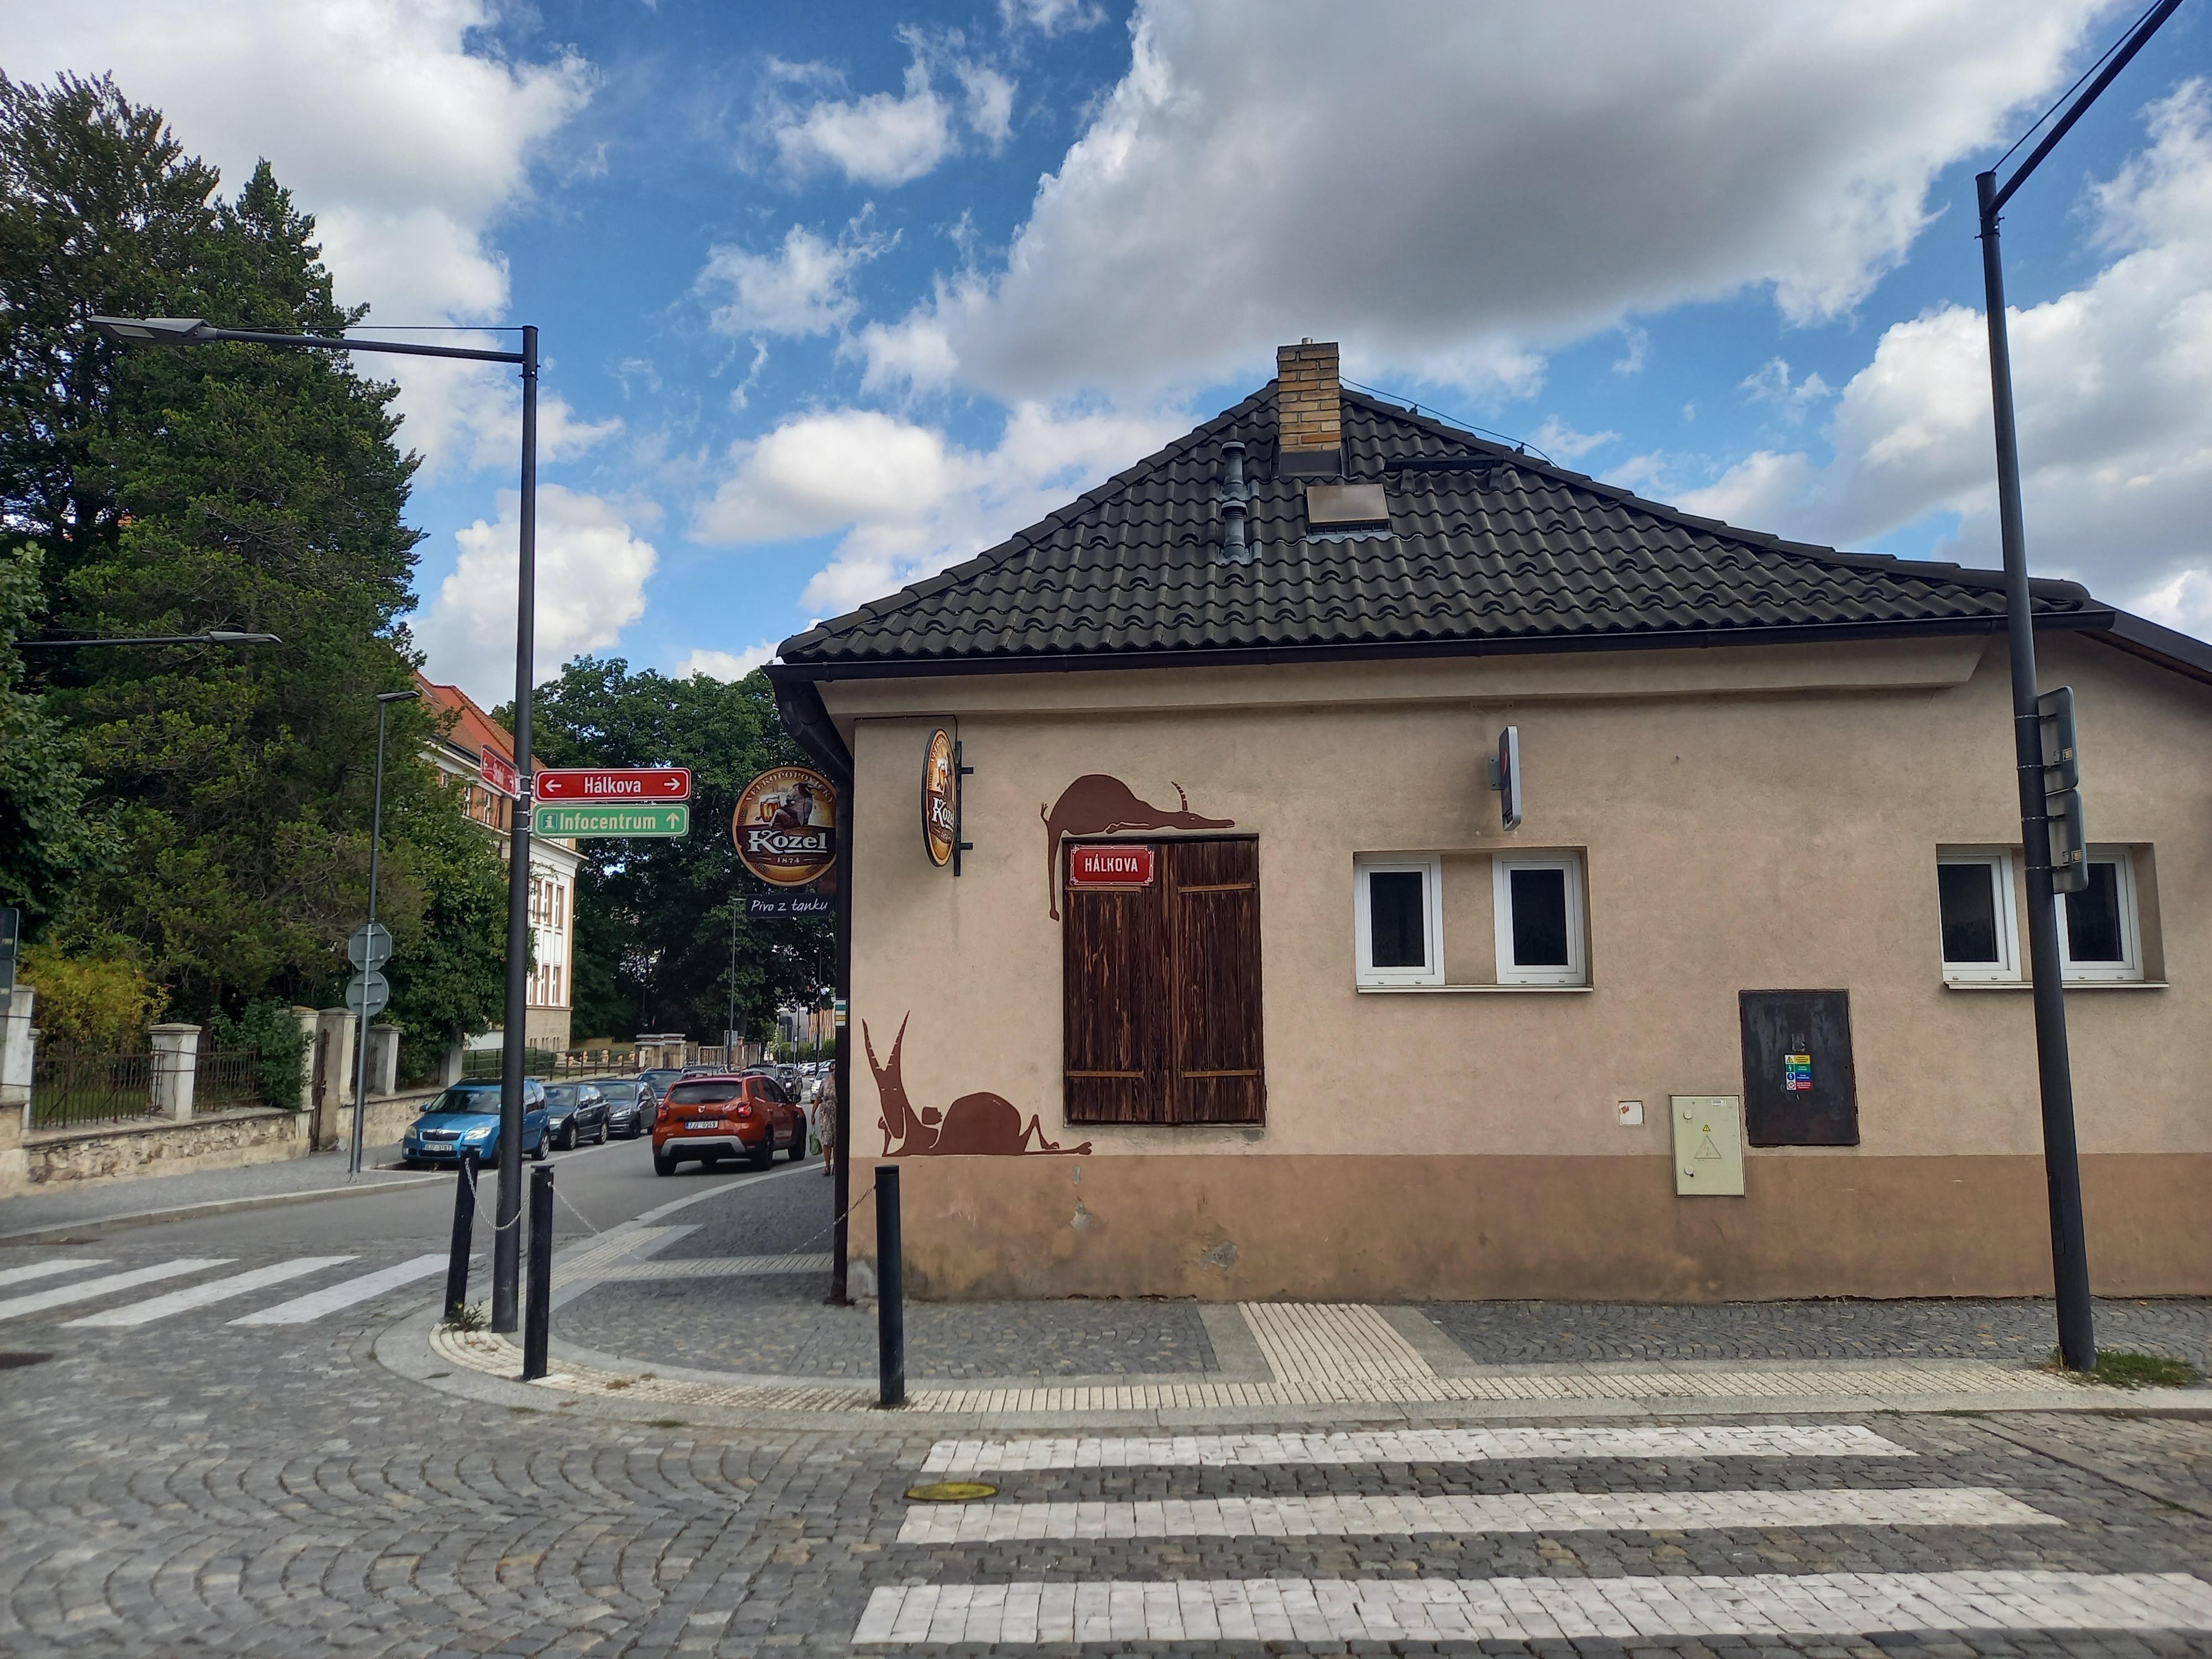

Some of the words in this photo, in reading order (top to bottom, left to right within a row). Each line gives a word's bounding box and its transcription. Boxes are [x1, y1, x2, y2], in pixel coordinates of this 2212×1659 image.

[585, 777, 641, 794] Hálkova
[560, 812, 656, 830] Infocentrum
[748, 830, 827, 853] Kozel
[1085, 853, 1138, 872] HÁLKOVA
[751, 900, 774, 912] Pivo
[778, 902, 787, 911] z
[791, 899, 828, 911] tanku
